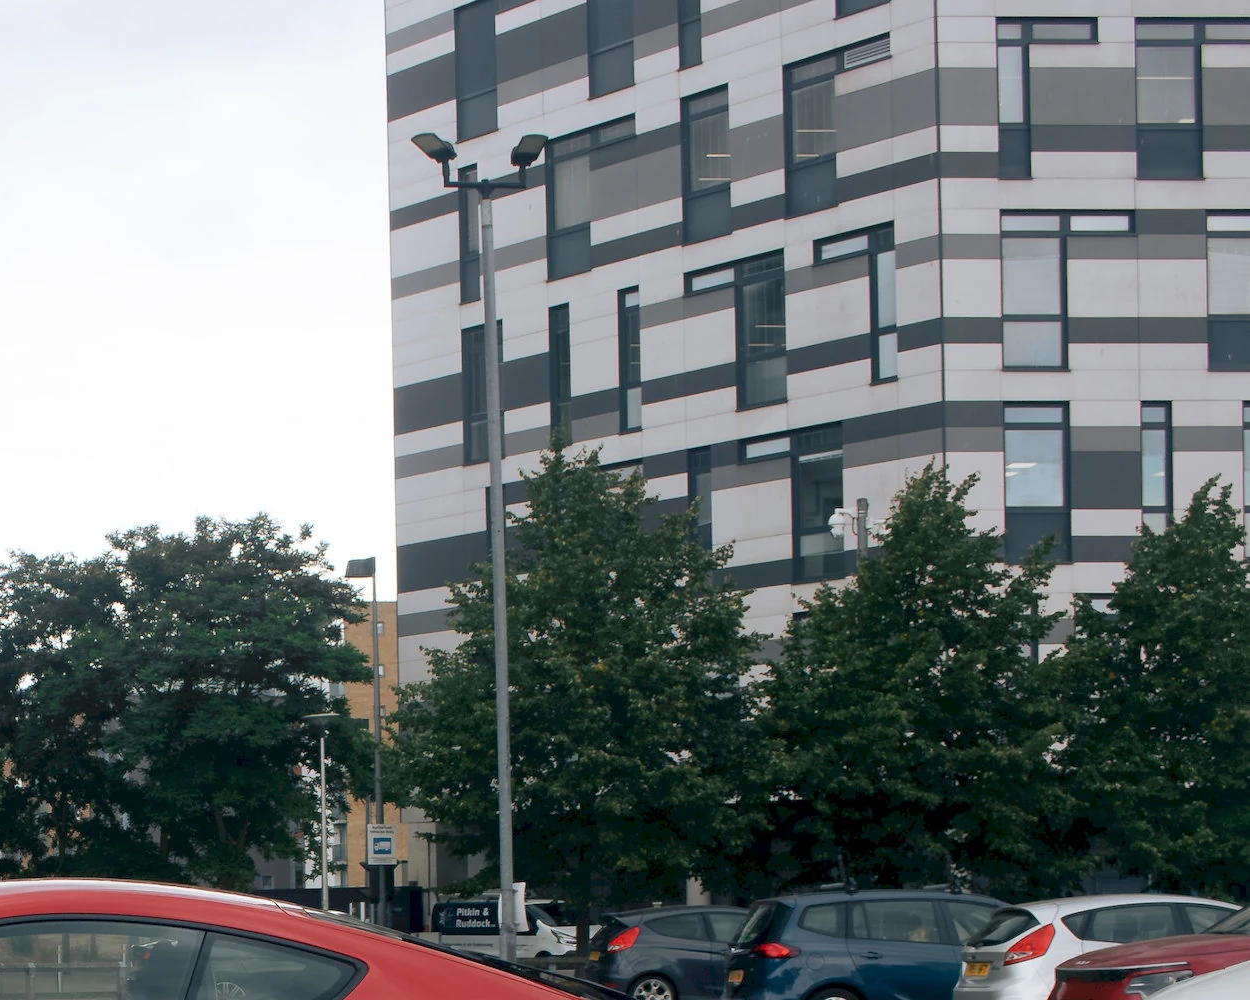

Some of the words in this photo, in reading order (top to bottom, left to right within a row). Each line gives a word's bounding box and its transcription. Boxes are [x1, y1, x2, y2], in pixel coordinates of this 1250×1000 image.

[456, 908, 480, 916] Pitkin
[482, 908, 489, 916] &
[456, 919, 490, 928] Ruddock
